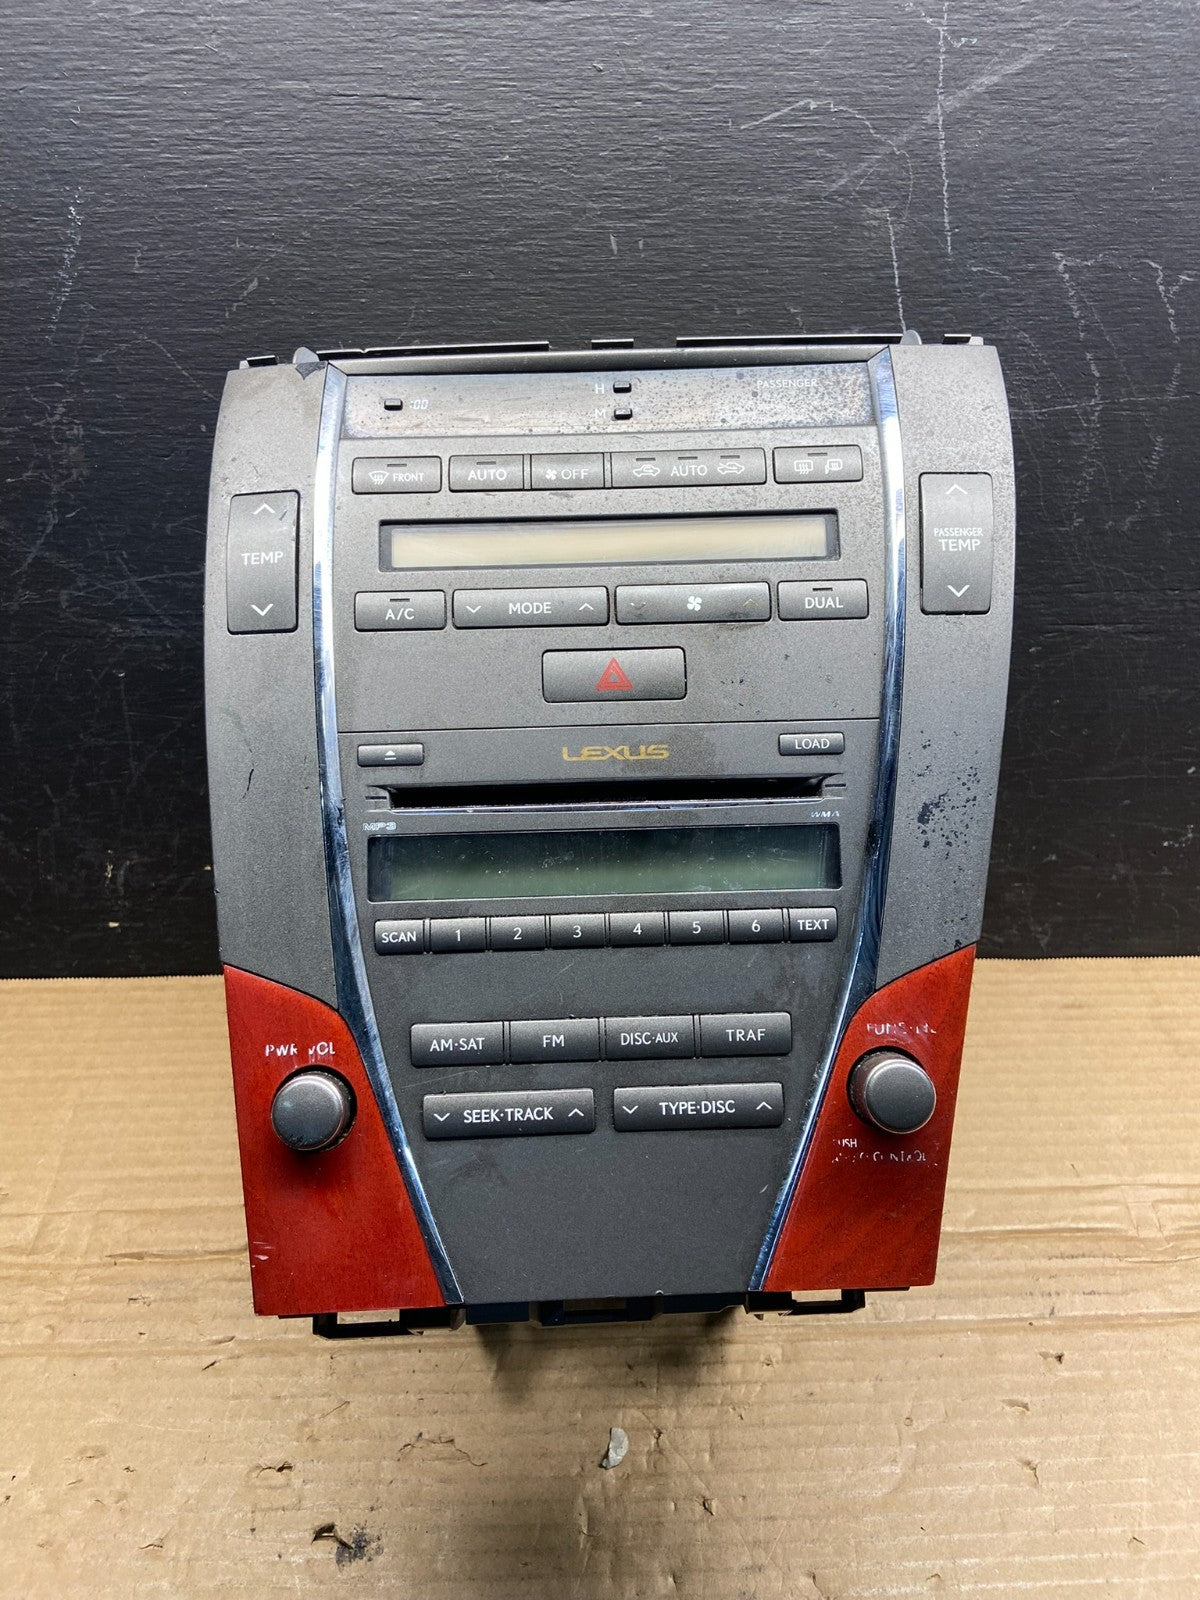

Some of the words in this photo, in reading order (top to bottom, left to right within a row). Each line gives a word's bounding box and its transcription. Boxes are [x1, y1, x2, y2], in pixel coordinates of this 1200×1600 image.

[757, 379, 818, 389] PASSENGER
[393, 471, 425, 482] FRONT
[468, 468, 508, 481] AUTO
[561, 468, 590, 480] OFF
[670, 465, 708, 477] AUTO
[933, 526, 984, 537] PASSENGER
[938, 538, 982, 552] TEMP
[241, 550, 284, 566] TEMP
[508, 601, 552, 615] MODE
[804, 597, 844, 610] DUAL
[385, 607, 415, 621] A/C
[795, 737, 830, 750] LOAD
[562, 744, 670, 762] LEXUS
[632, 923, 642, 935] 4
[692, 921, 702, 934] 5
[751, 919, 761, 933] 6
[797, 918, 830, 931] TEXT
[381, 931, 417, 944] SCAN
[454, 930, 462, 942] 1
[512, 927, 522, 940] 2
[572, 925, 582, 938] 3
[543, 1034, 565, 1048] FM
[620, 1031, 679, 1046] DISC·AUX
[725, 1028, 766, 1042] TRAF
[430, 1037, 486, 1052] AM·SAT
[658, 1100, 736, 1116] TYPE·DISC
[463, 1107, 554, 1124] SEEK·TRACK
